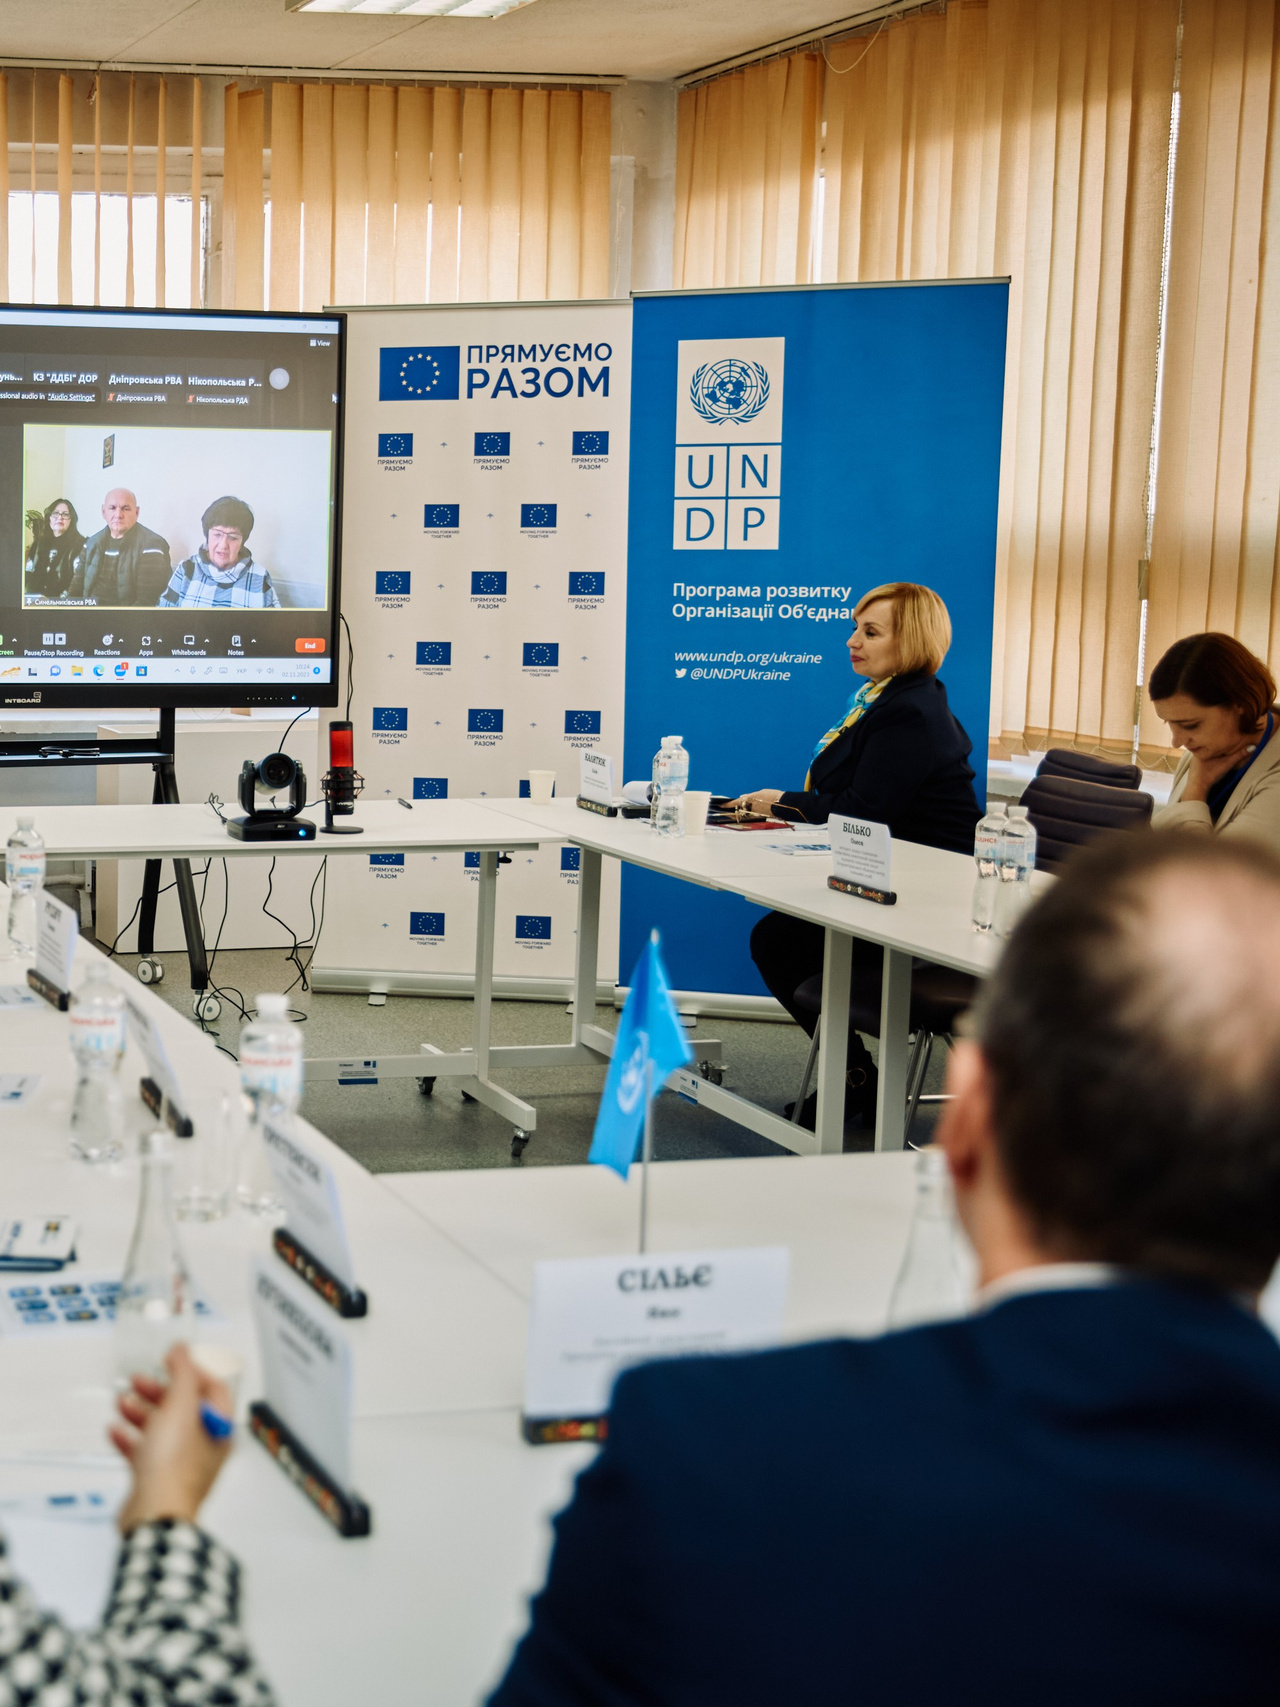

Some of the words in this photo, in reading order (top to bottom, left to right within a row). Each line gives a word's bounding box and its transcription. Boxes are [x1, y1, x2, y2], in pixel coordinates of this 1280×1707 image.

[467, 342, 613, 364] ПРЯМУЄМО
[33, 373, 45, 382] КЗ
[78, 374, 98, 384] ДОР
[109, 374, 163, 386] Дніпровська
[165, 376, 182, 385] РВА
[188, 377, 246, 387] Нікопольська
[466, 366, 610, 399] РАЗОМ
[116, 395, 153, 403] Дніпровська
[672, 582, 761, 601] Програма
[766, 585, 851, 602] розвитку
[672, 603, 773, 621] Організації
[24, 650, 55, 658] Pause/Stop
[56, 650, 84, 658] Recording
[674, 650, 823, 666] www.undp.org/ukraine
[690, 668, 791, 681] @UNDPUkraine
[842, 822, 871, 837] БІЛЬКО
